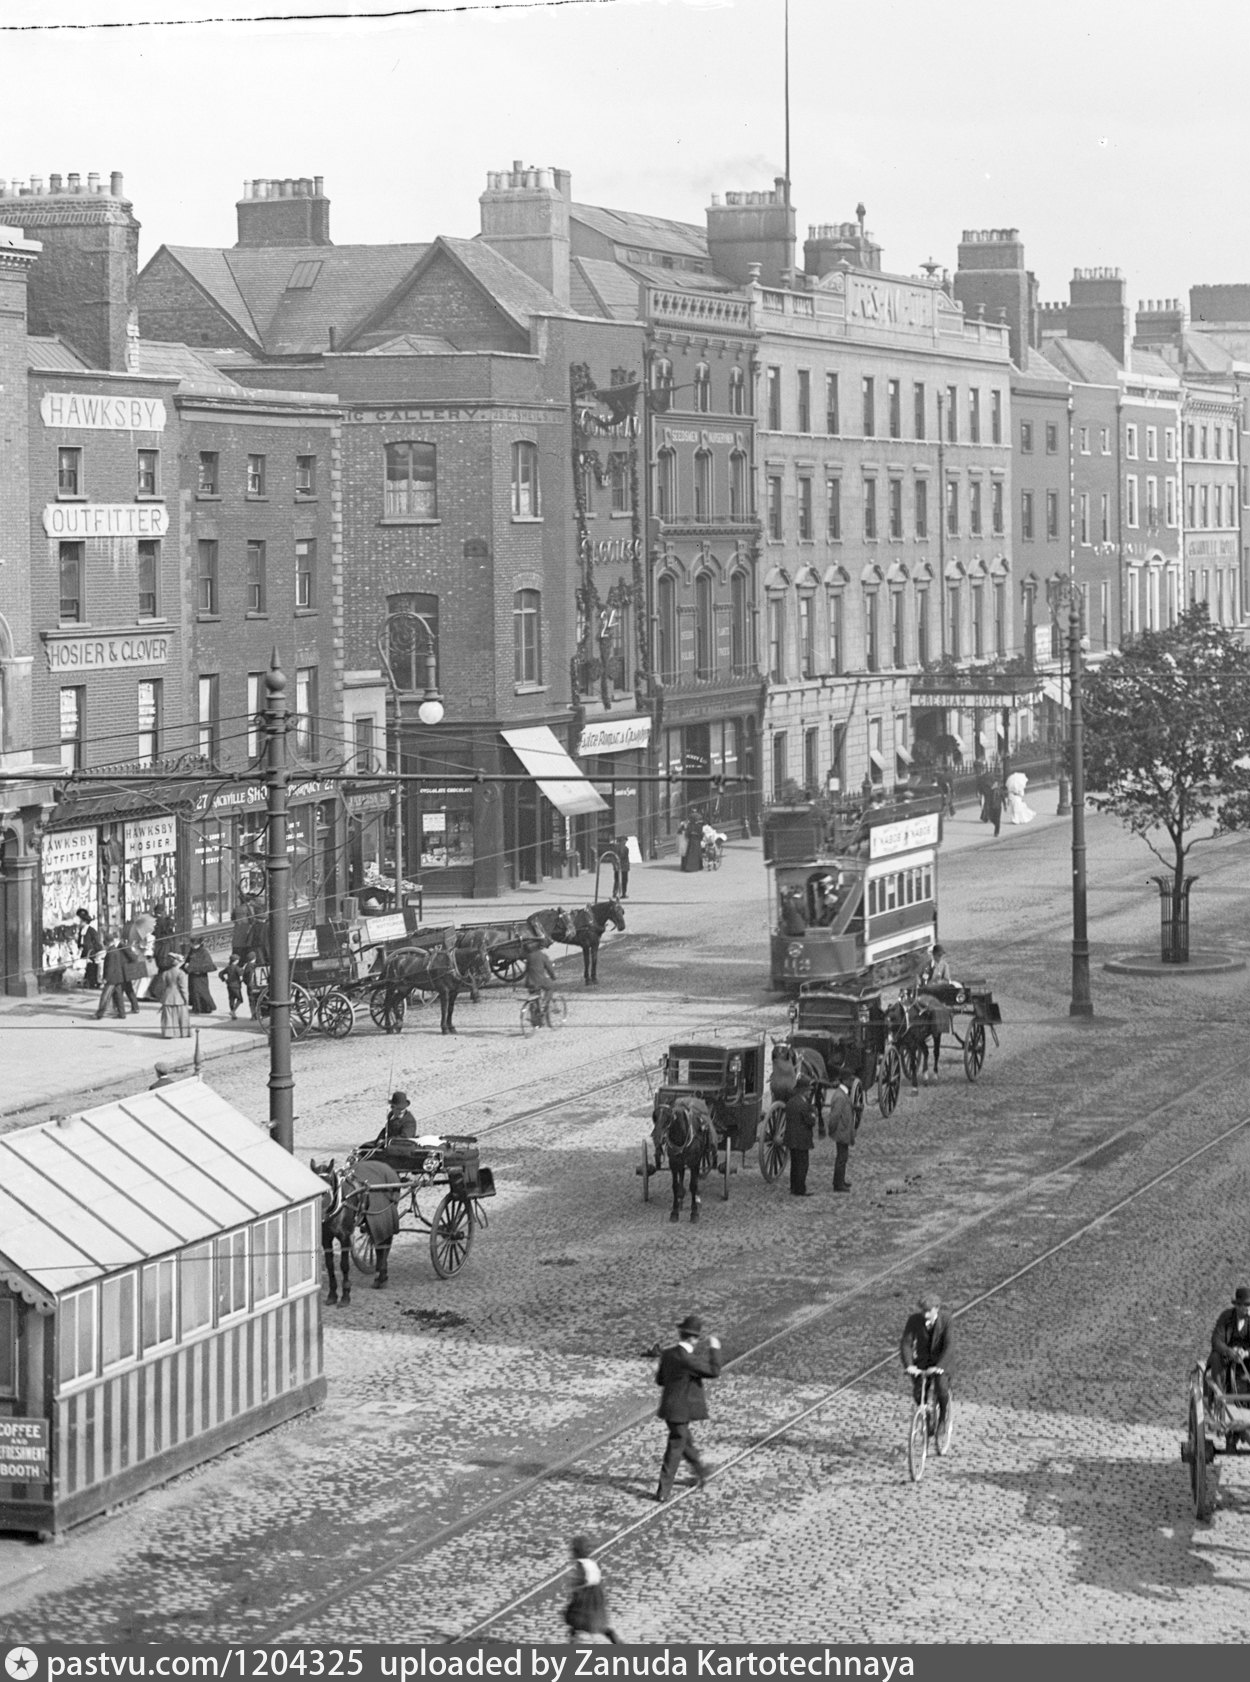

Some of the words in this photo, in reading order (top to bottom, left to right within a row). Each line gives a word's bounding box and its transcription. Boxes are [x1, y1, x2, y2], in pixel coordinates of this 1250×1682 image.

[50, 395, 157, 429] HAWKSBY
[52, 507, 162, 533] OUTFITTER
[51, 641, 104, 667] HOSIER
[108, 640, 119, 663] &
[974, 694, 1004, 707] HOTEL
[125, 822, 175, 840] HAWKSBY
[129, 837, 170, 852] HOSIER
[43, 849, 95, 867] UTFITTER
[0, 1463, 41, 1478] BOOTH
